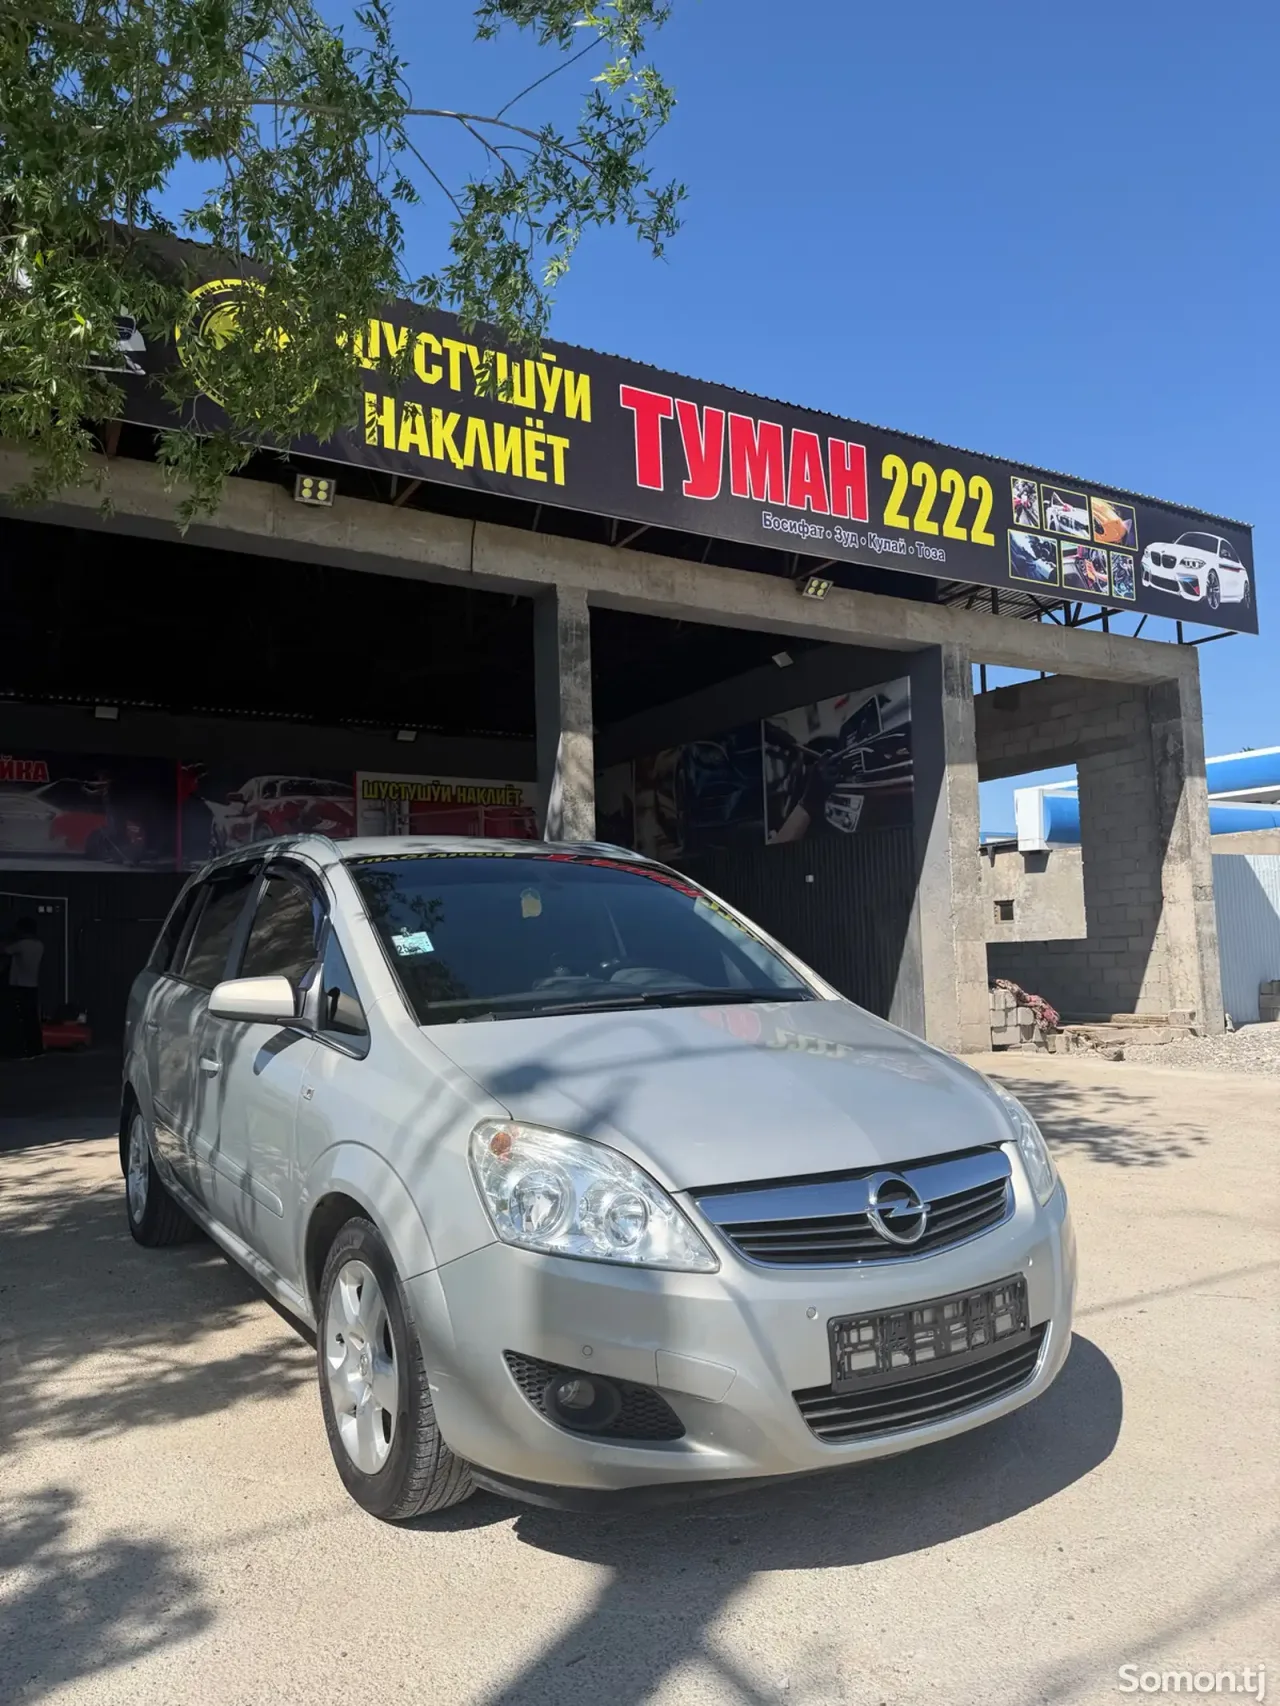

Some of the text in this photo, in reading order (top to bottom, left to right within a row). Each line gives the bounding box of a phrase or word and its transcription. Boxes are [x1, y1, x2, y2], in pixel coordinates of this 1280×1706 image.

[364, 391, 570, 486] НАҚЛИЁТ
[619, 383, 995, 547] ТУМАН 2222
[762, 511, 824, 539] Босифат
[834, 526, 859, 548] Зуд
[915, 541, 946, 562] Тоза
